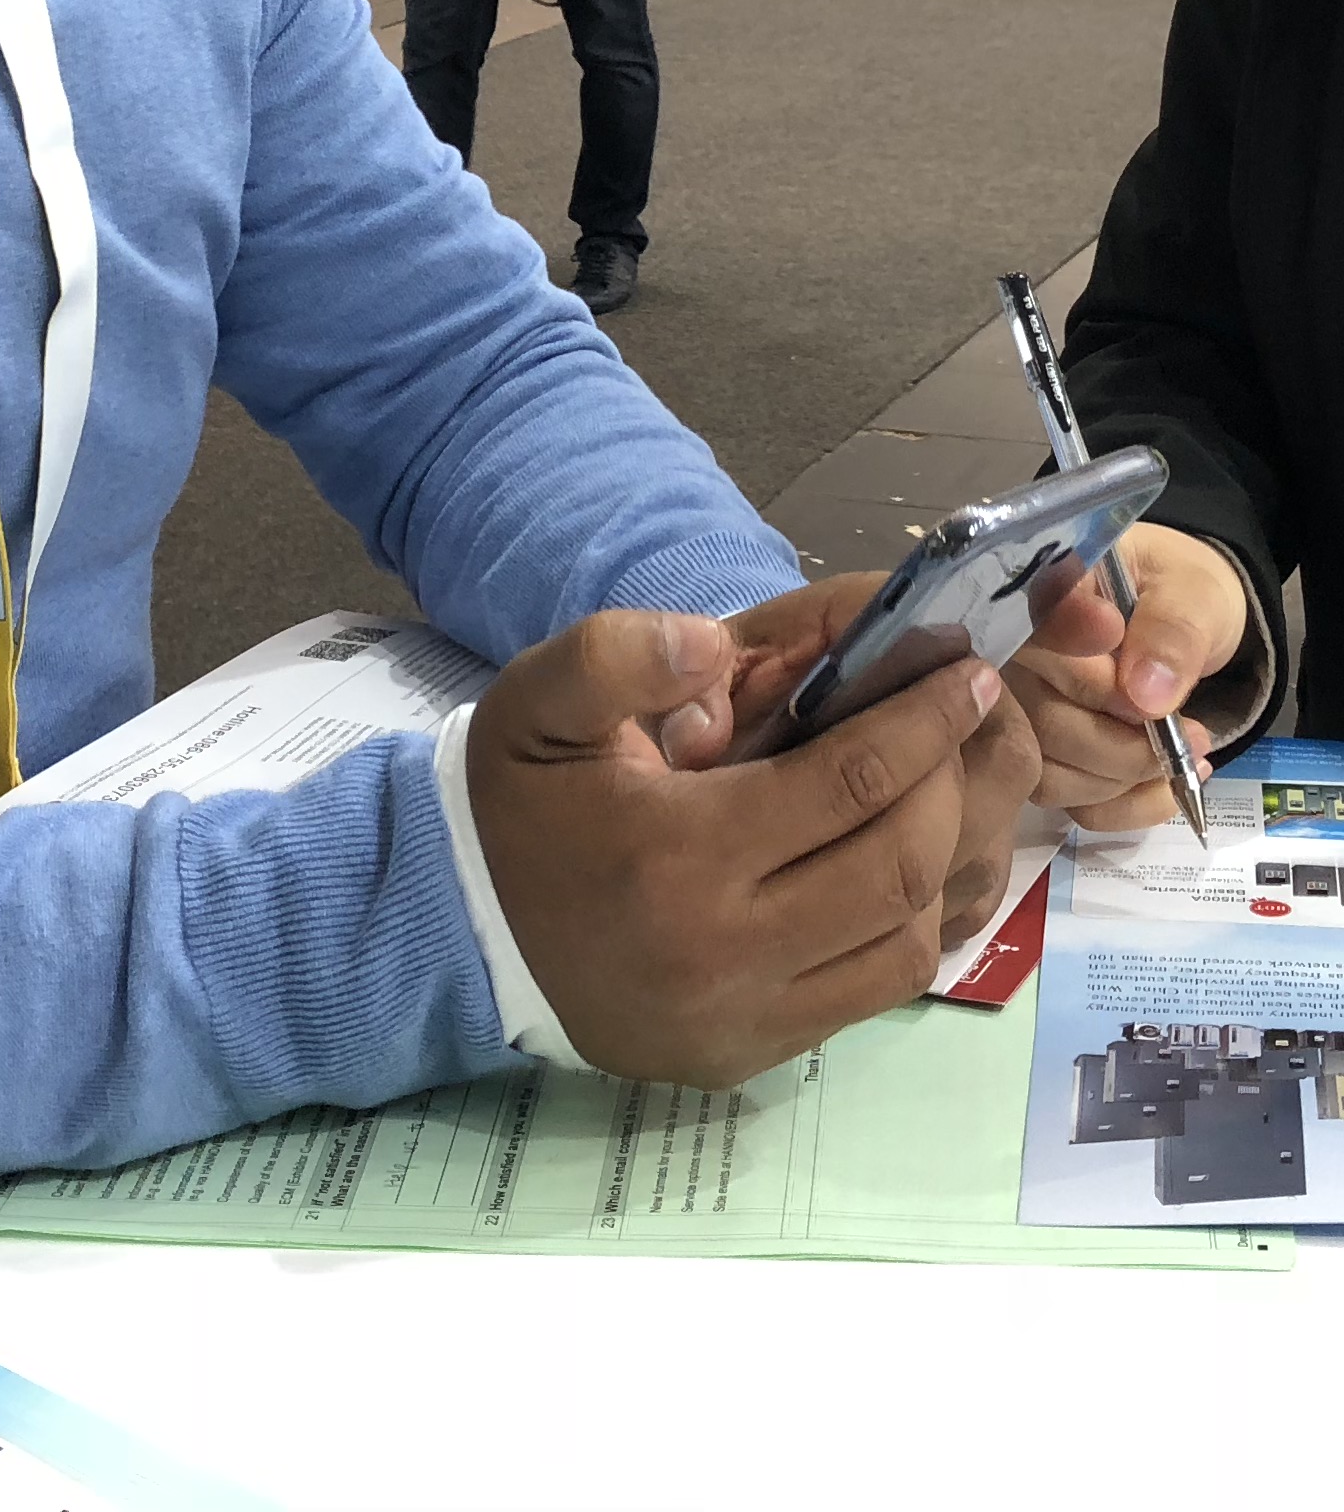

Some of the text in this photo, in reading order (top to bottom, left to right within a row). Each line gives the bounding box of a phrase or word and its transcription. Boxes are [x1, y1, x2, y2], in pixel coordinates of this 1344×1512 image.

[1028, 313, 1041, 334] PEN
[1034, 333, 1047, 353] GEL
[1141, 885, 1199, 893] Inverter
[1088, 954, 1113, 962] 100
[1121, 955, 1153, 963] than
[1202, 958, 1262, 967] covered
[1267, 960, 1329, 969] network
[1122, 965, 1167, 973] motor
[1244, 968, 1321, 979] frequency
[1086, 973, 1164, 983] customers
[1169, 975, 1244, 987] providing
[1274, 979, 1339, 990] focusing
[1087, 984, 1122, 992] With
[1085, 1003, 1333, 1019] industry and energy
[1261, 1001, 1292, 1009] best
[804, 1058, 819, 1082] Thank
[512, 1120, 525, 1138] you
[663, 1118, 676, 1138] trade
[508, 1136, 520, 1151] are
[661, 1139, 674, 1155] your
[721, 1119, 737, 1160] HANNOVER
[680, 1091, 712, 1212] Service options related to your trade
[656, 1155, 670, 1167] for
[721, 1161, 731, 1169] at
[497, 1152, 516, 1188] satisfied
[613, 1156, 627, 1182] e-mail
[330, 1154, 361, 1207] What are the
[652, 1166, 668, 1194] formats
[718, 1170, 730, 1194] events
[489, 1190, 505, 1210] How
[604, 1184, 621, 1213] Which
[649, 1196, 663, 1213] New
[712, 1195, 727, 1212] Side
[304, 1210, 320, 1220] 21
[484, 1214, 500, 1226] 22
[600, 1217, 615, 1228] 23
